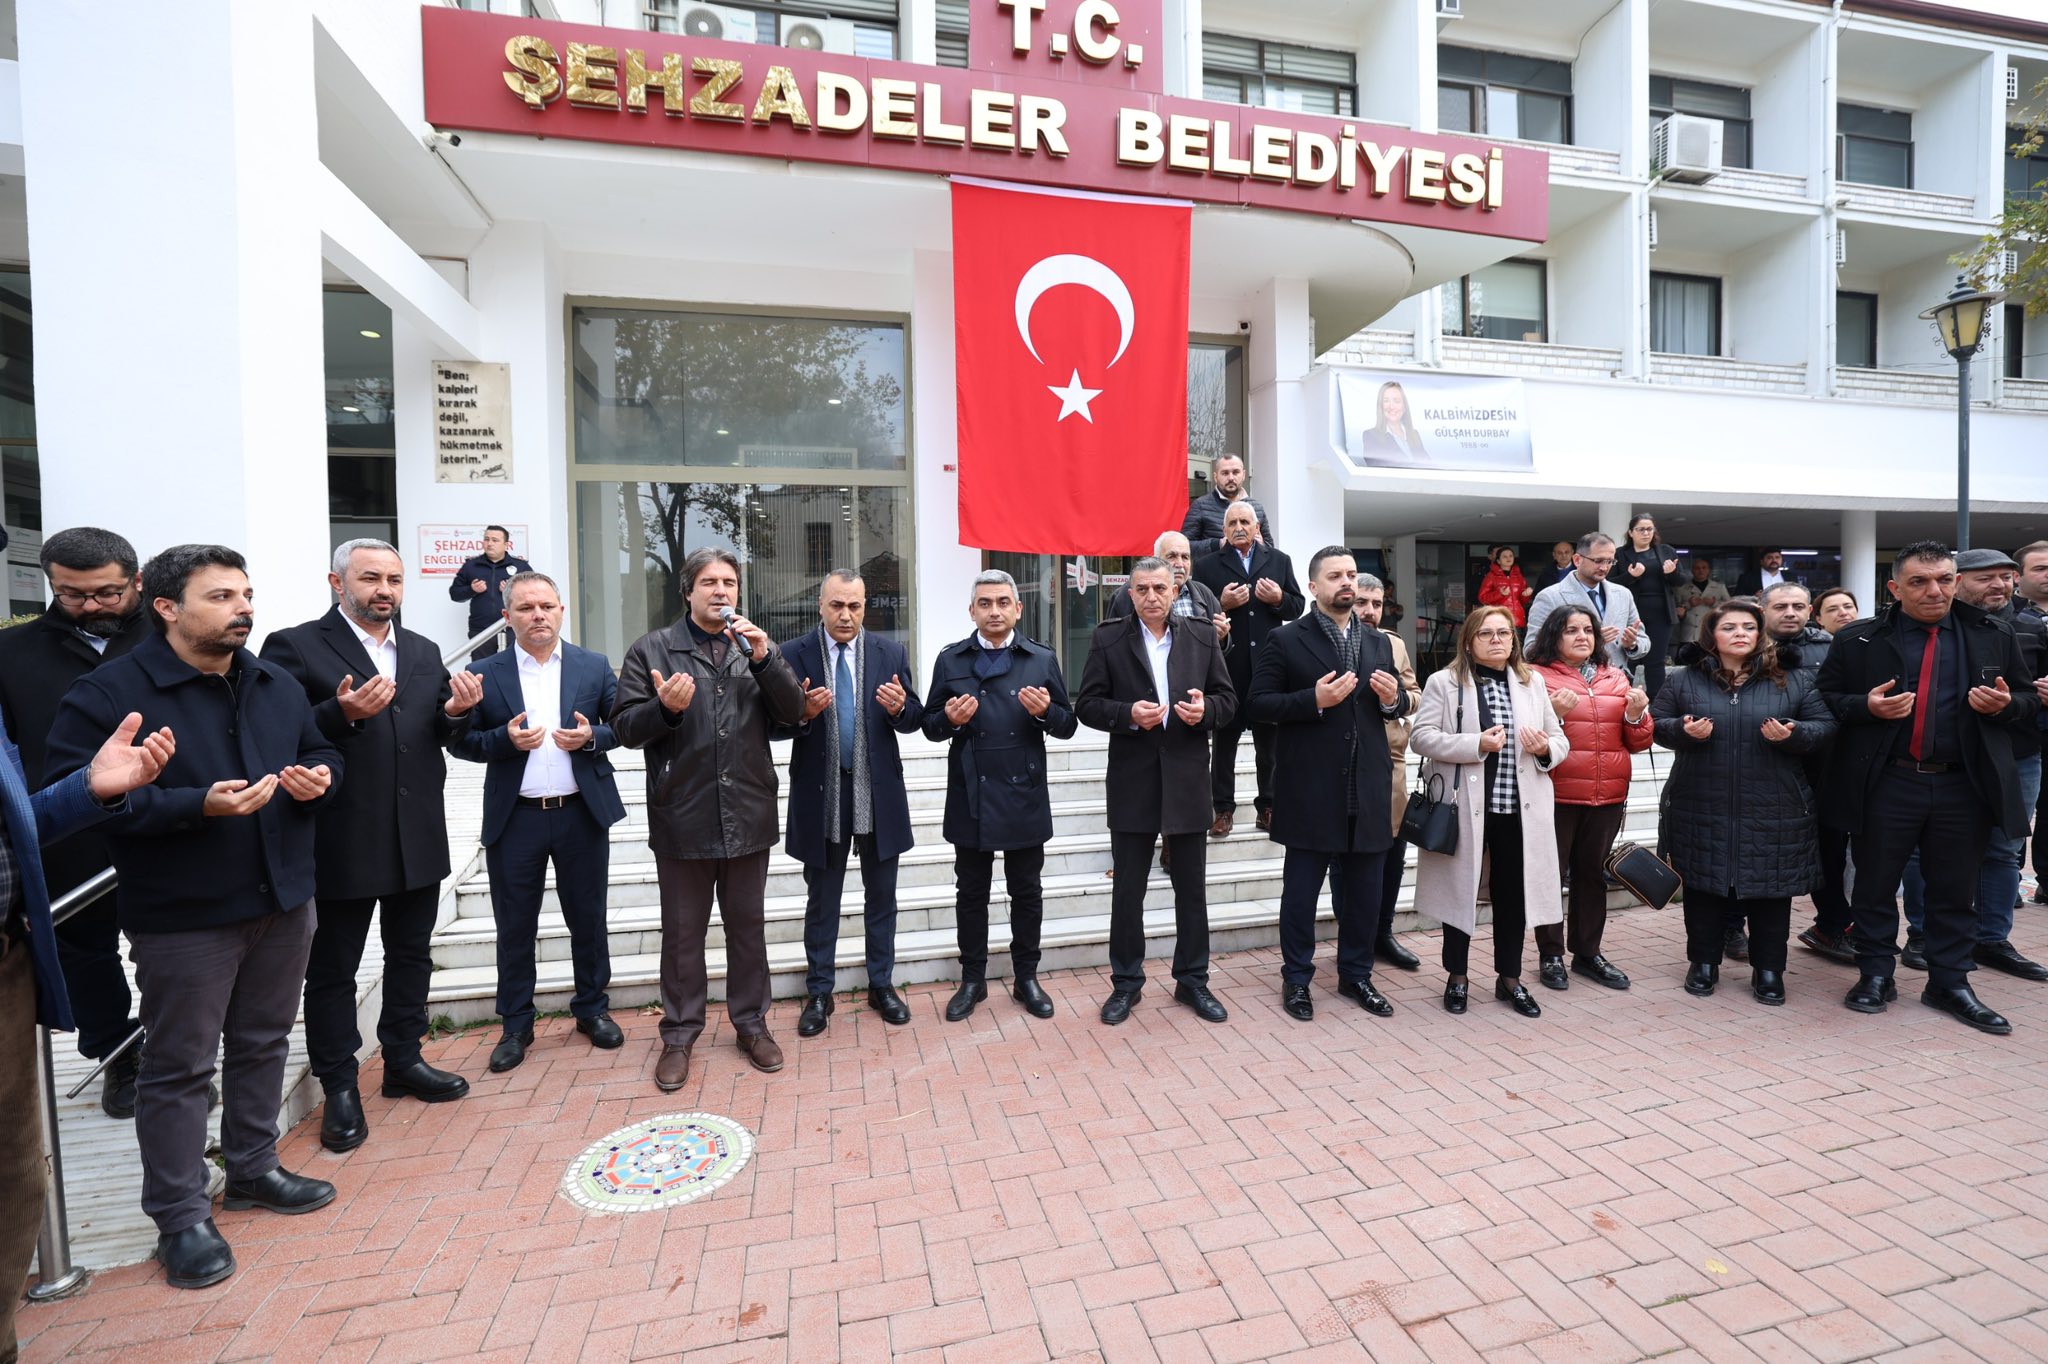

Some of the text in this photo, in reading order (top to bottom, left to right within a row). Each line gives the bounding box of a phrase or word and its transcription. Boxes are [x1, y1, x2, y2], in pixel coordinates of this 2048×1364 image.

[998, 0, 1143, 67] T.C.
[502, 35, 1503, 211] ŞEHZADELER BELEDİYESİ
[438, 369, 469, 381] "Ben;
[438, 384, 478, 396] kalpleri
[438, 398, 477, 408] kırarak
[439, 412, 468, 423] değil,
[1424, 406, 1517, 421] KALBİMİZDESİN
[439, 426, 495, 436] kazanarak
[1434, 426, 1510, 439] GÜLŞAH DURBAY
[439, 440, 503, 450] hükmetmek
[440, 454, 488, 464] isterim."
[434, 540, 514, 553] ŞEHZADR
